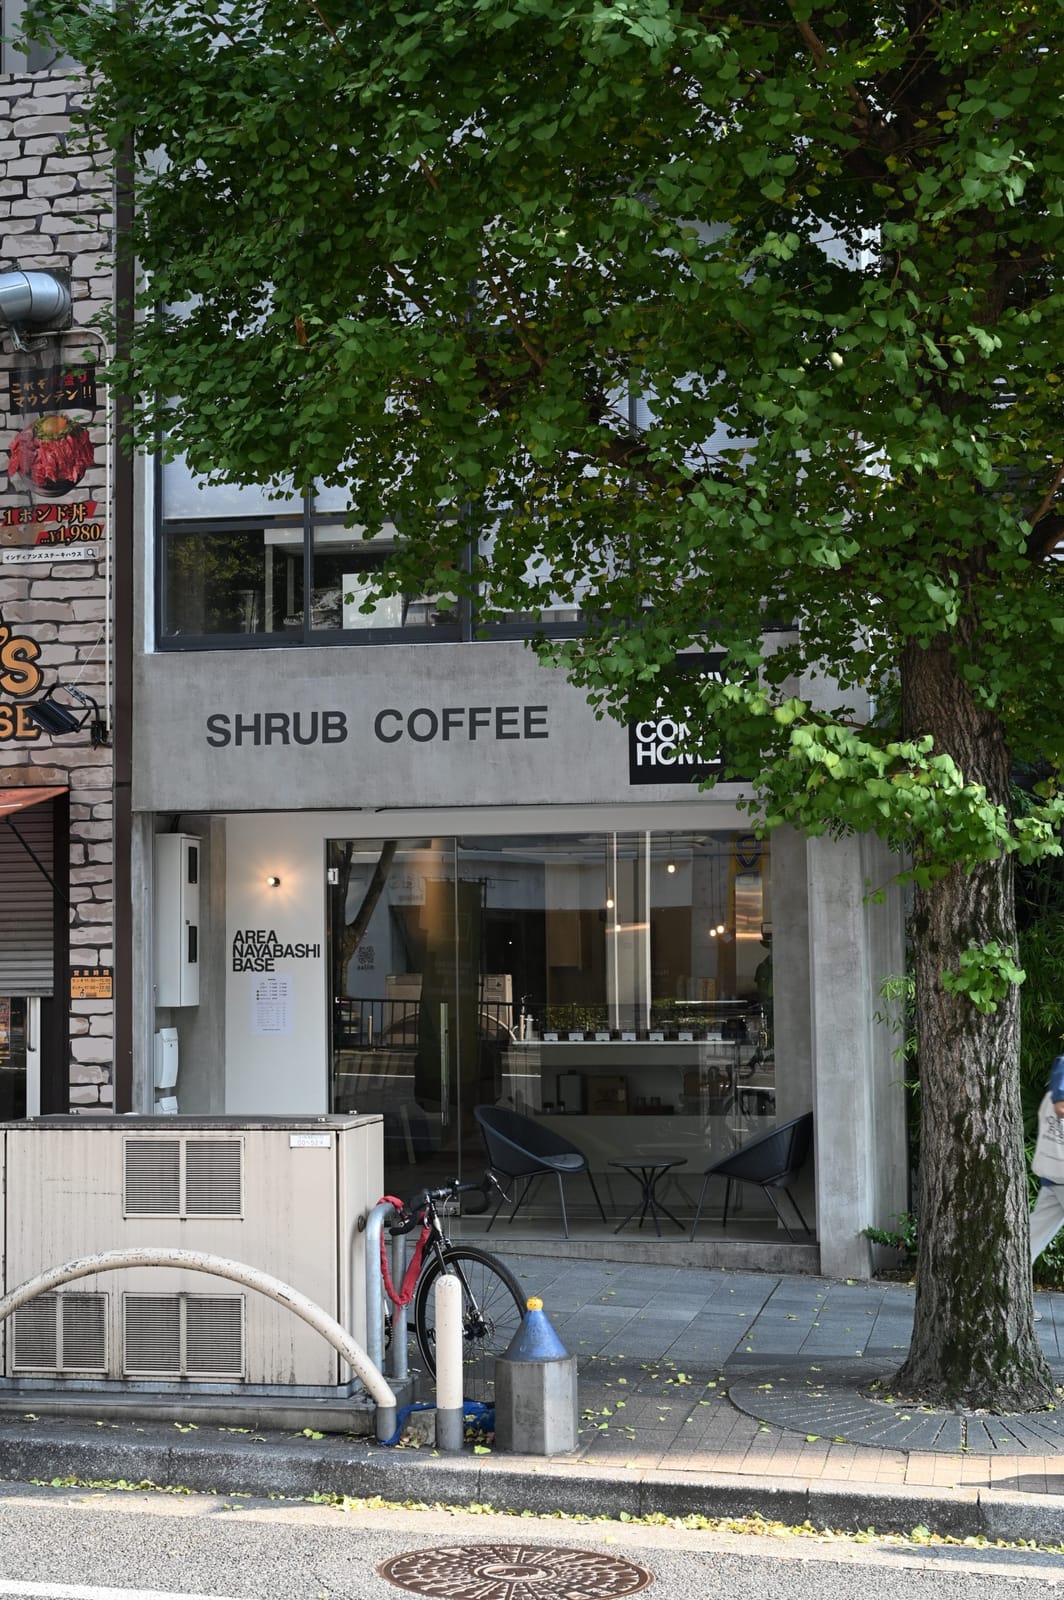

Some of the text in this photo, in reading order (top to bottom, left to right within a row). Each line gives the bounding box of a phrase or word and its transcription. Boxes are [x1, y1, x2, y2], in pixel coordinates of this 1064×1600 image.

[206, 706, 549, 747] SHRUB COFFEE
[233, 930, 278, 944] AREA
[233, 943, 320, 958] NAYABASHI
[233, 958, 275, 972] BASE
